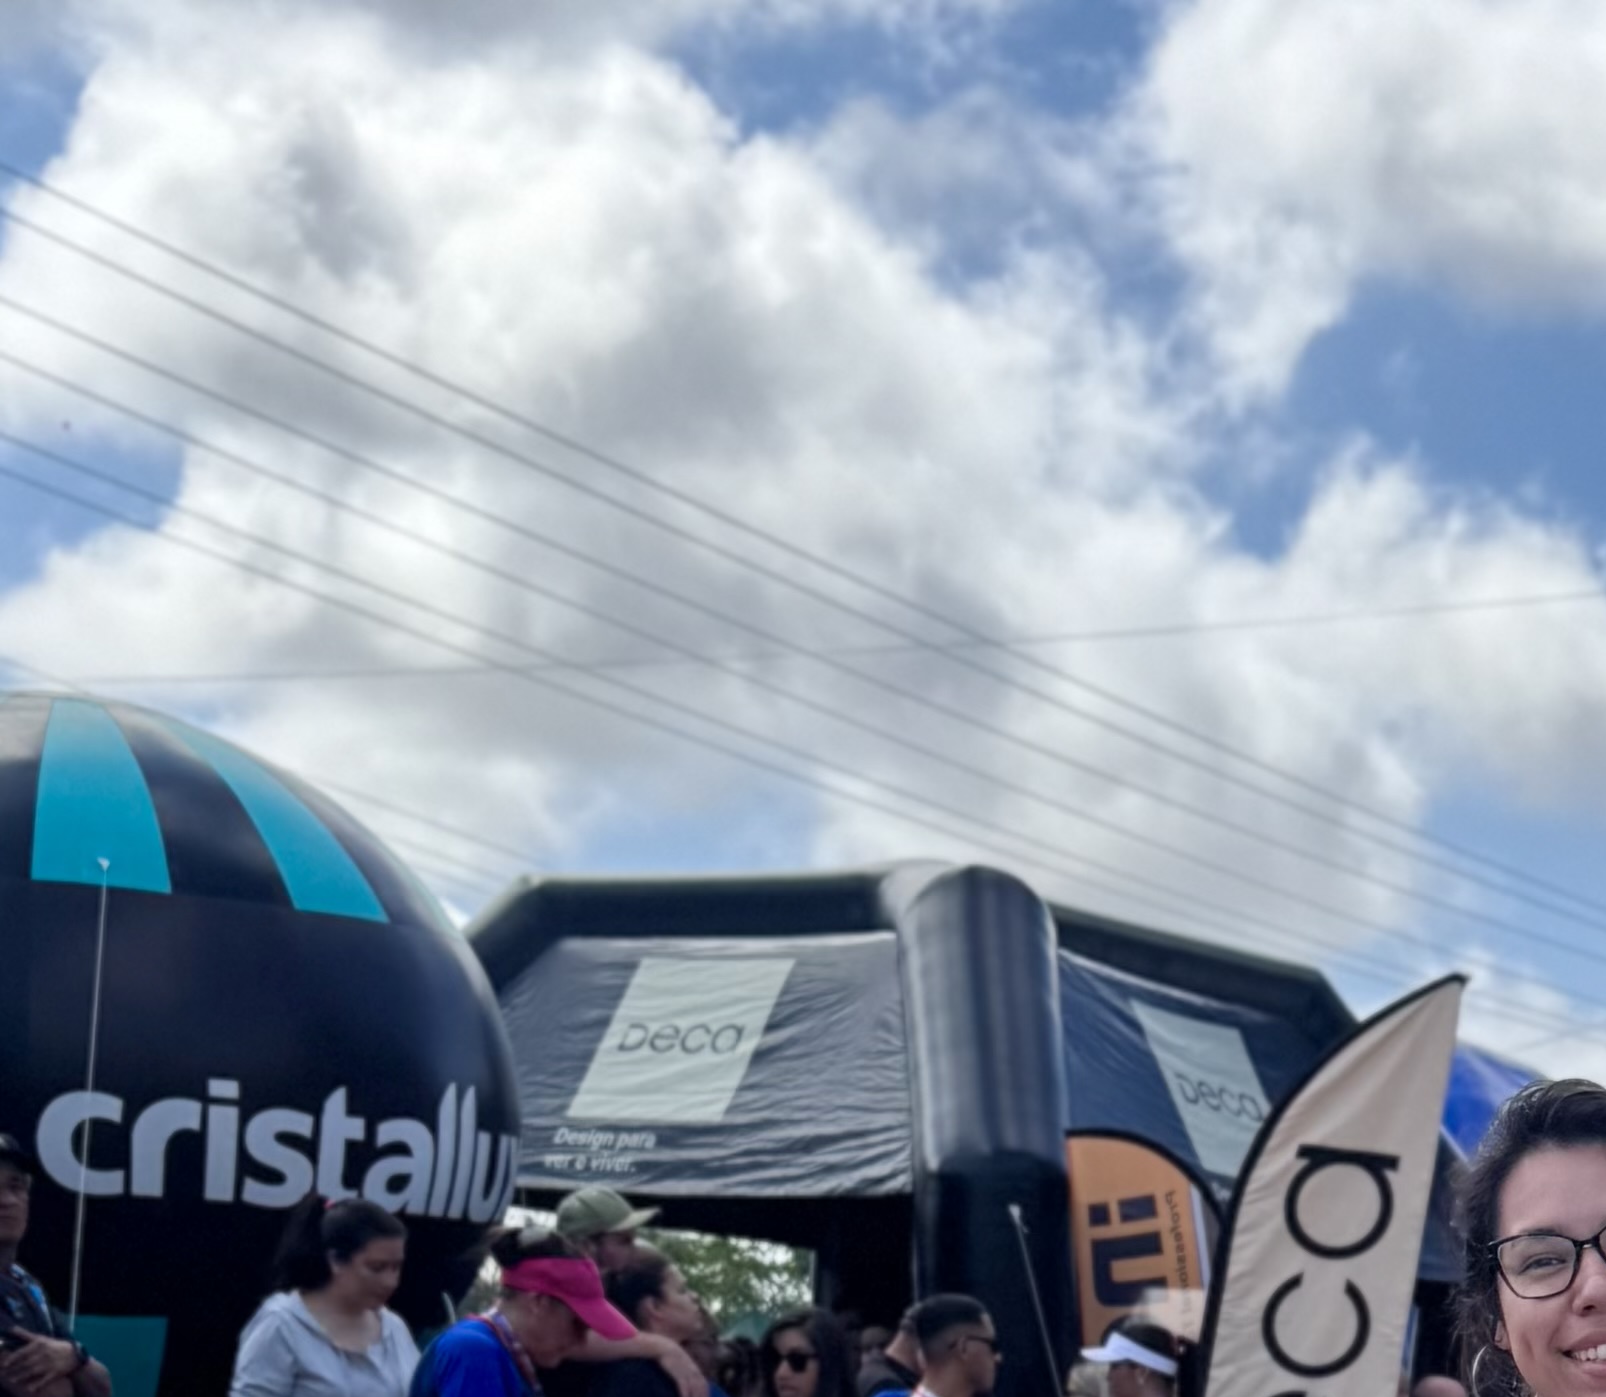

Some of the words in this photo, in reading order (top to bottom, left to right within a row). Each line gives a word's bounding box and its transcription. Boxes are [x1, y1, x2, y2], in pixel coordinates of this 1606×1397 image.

[617, 1023, 745, 1054] Deca
[37, 1078, 518, 1222] cristallu
[553, 1127, 615, 1149] Design
[615, 1132, 656, 1150] para
